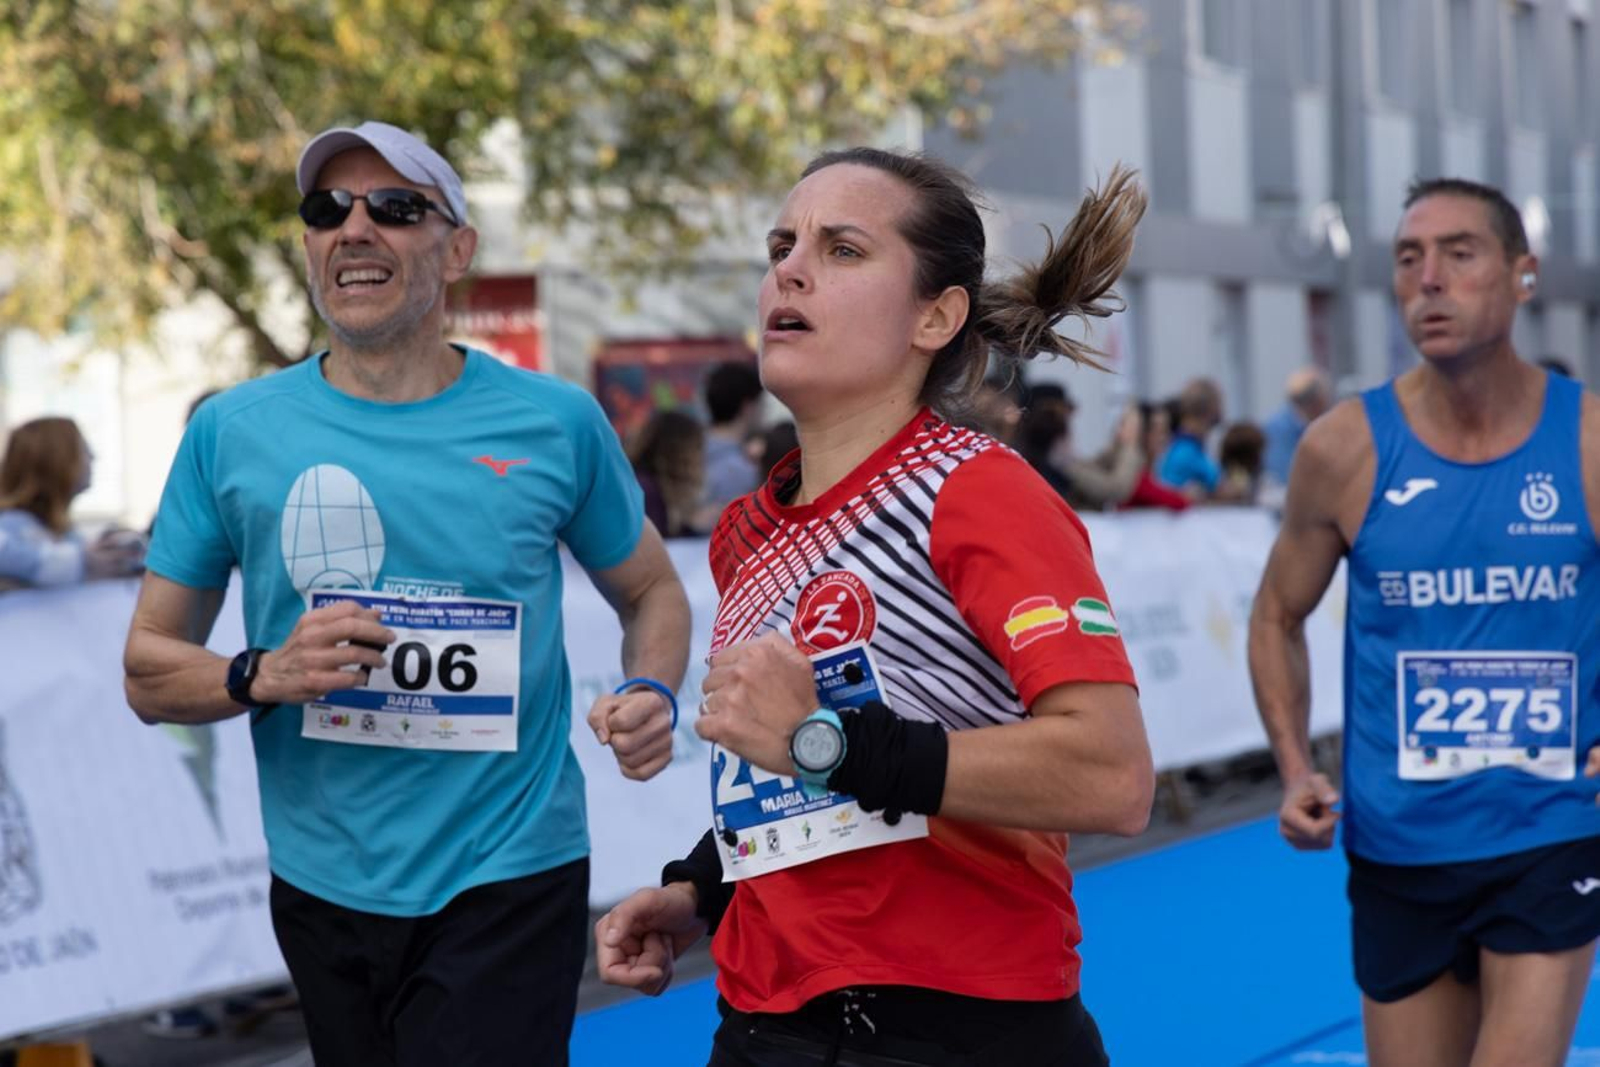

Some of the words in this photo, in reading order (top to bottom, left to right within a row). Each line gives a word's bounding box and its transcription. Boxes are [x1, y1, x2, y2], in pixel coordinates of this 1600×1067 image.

[820, 572, 861, 590] ZANCADA
[1408, 564, 1580, 608] BULEVAR
[386, 694, 435, 709] RAFAEL
[1413, 687, 1563, 733] 2275
[760, 790, 805, 814] MARIA
